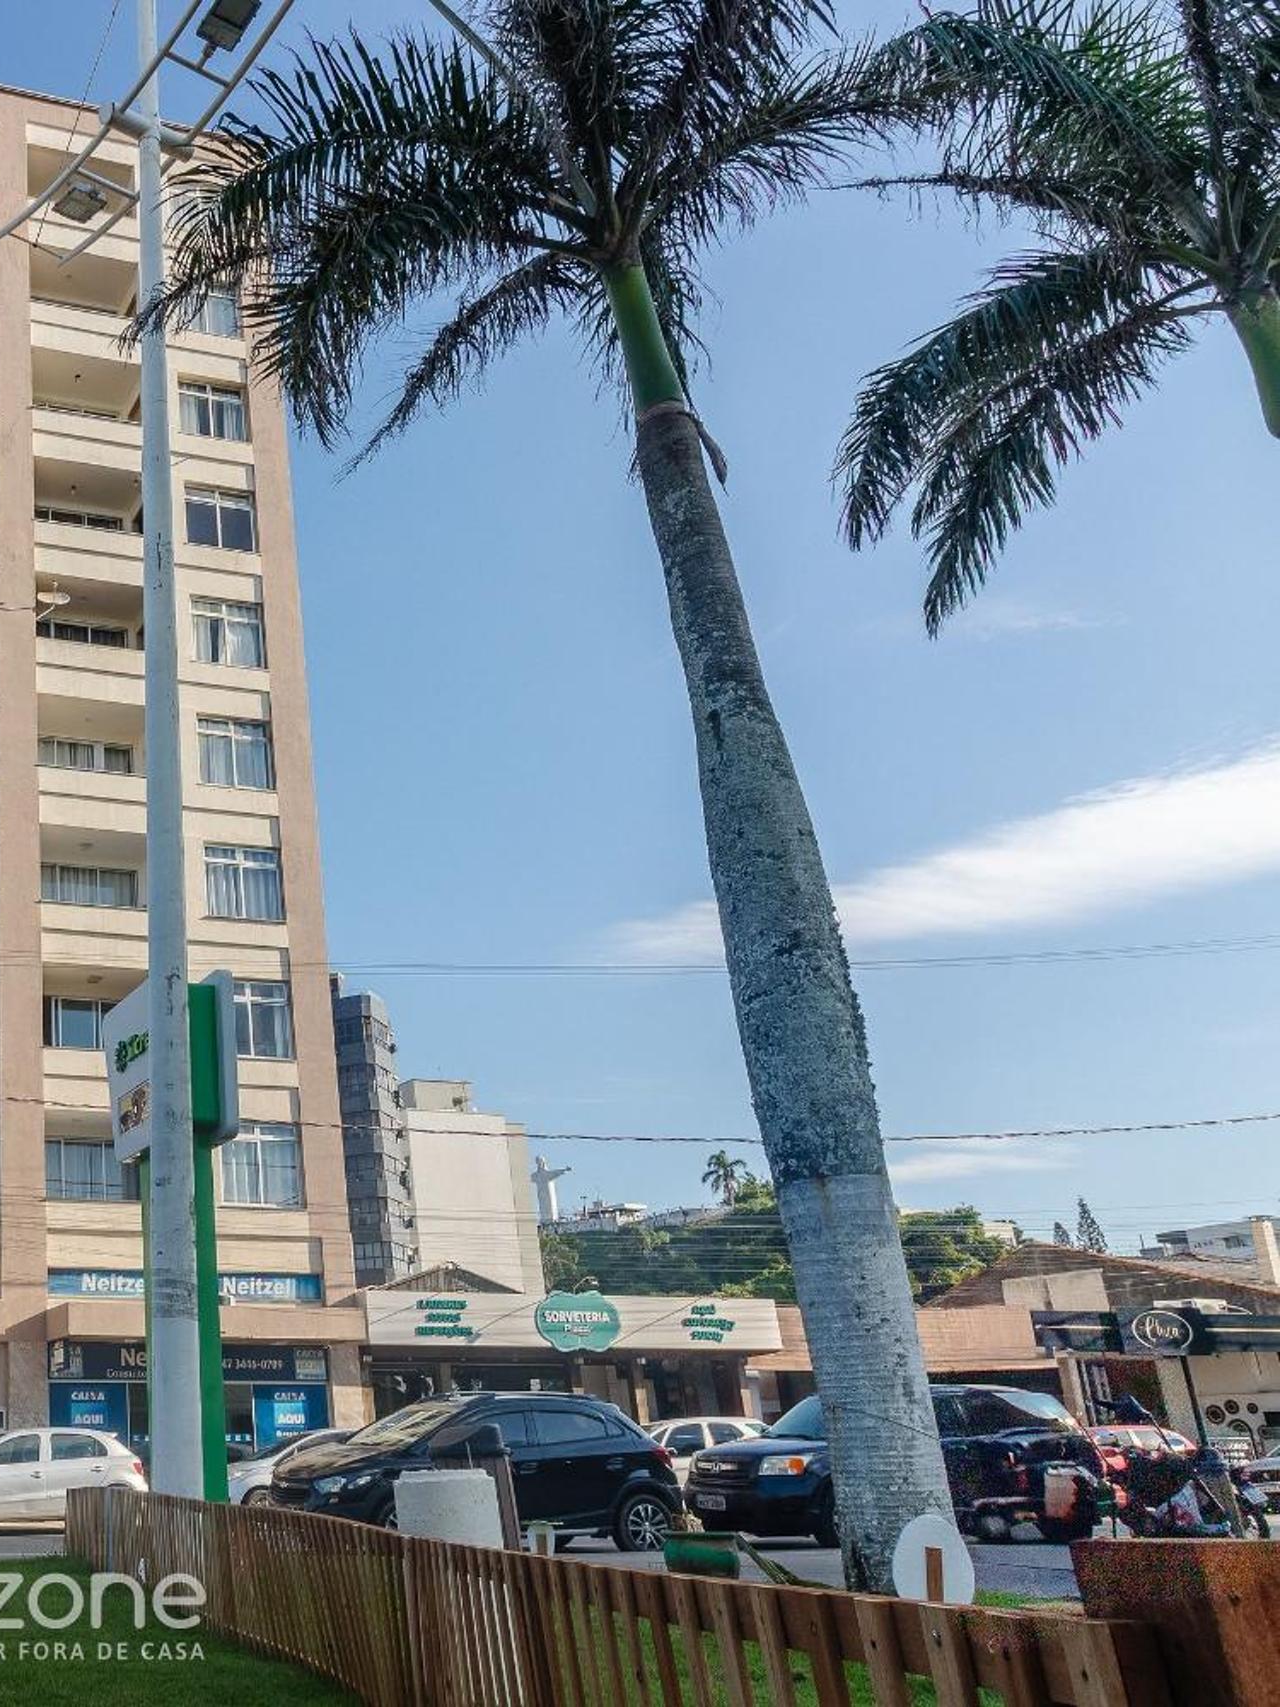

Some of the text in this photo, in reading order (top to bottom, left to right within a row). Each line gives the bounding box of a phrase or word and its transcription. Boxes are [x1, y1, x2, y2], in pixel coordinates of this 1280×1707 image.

[81, 1272, 145, 1291] Neitze
[544, 1310, 610, 1323] SORVETERIA
[120, 1348, 146, 1367] Ne
[71, 1391, 105, 1400] CAIXA
[274, 1392, 306, 1400] CAIXA
[74, 1413, 104, 1424] AQUI
[277, 1413, 305, 1424] AQUI
